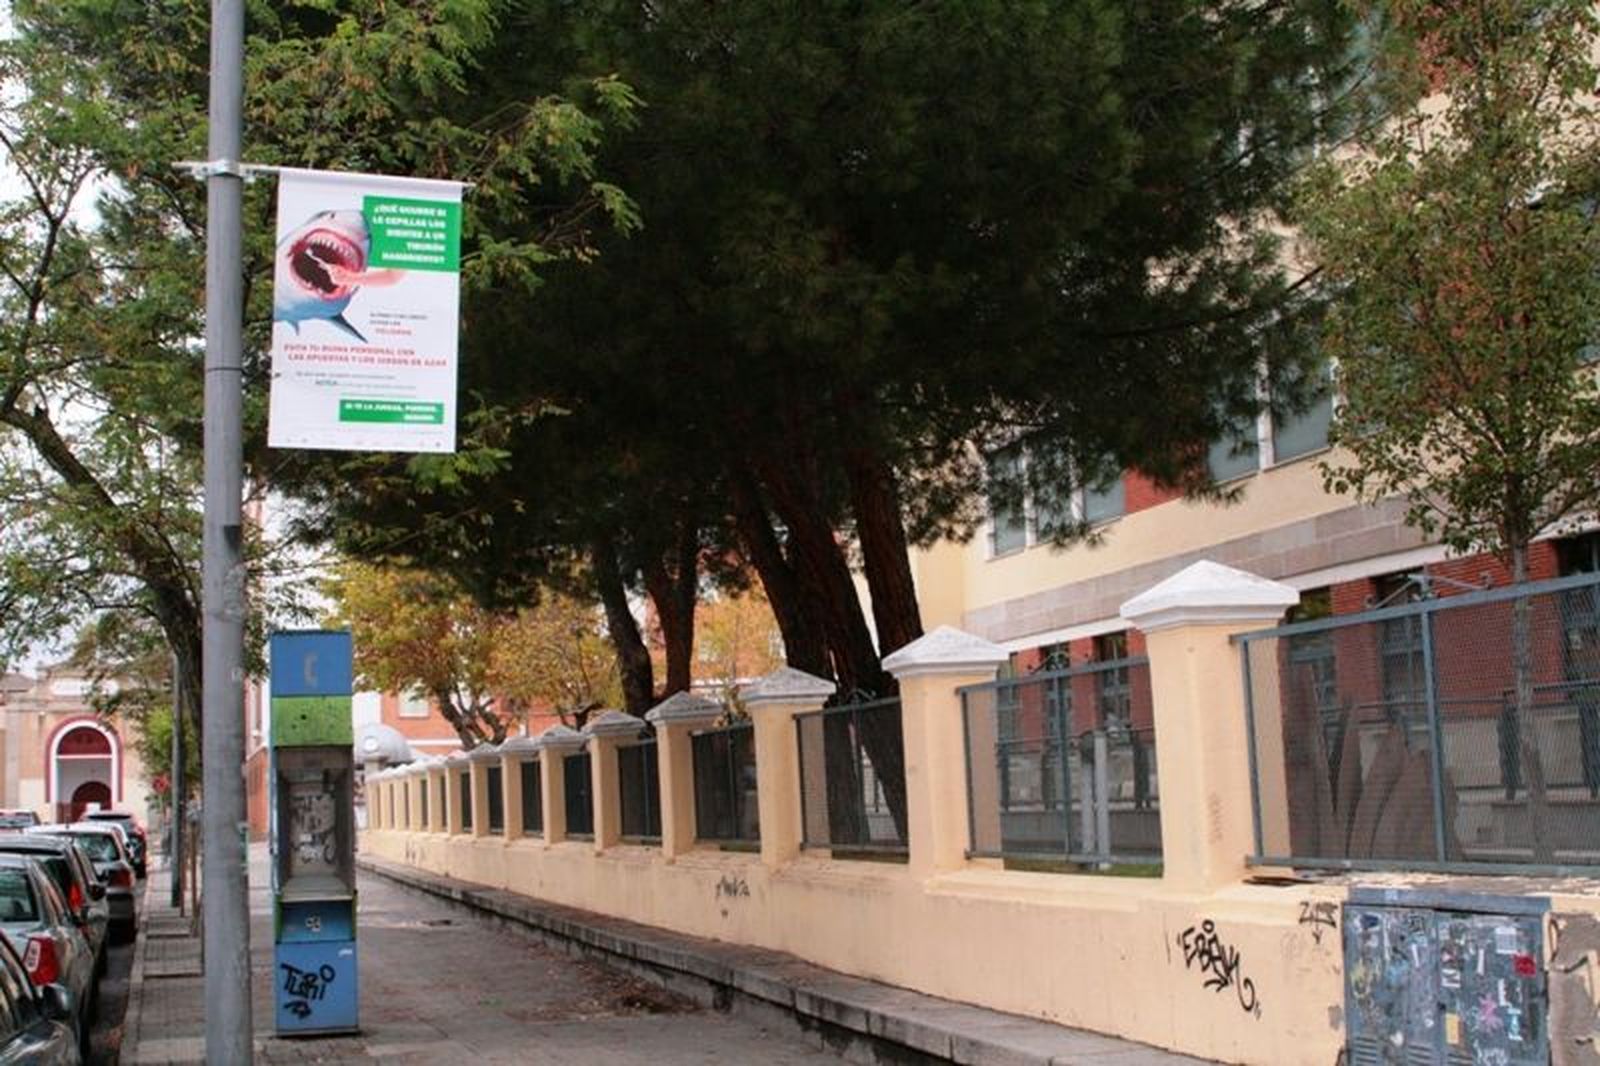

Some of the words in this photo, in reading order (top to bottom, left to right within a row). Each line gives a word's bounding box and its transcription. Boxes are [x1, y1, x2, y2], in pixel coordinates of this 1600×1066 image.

[373, 216, 384, 224] LE
[386, 217, 426, 228] CEPILLAS
[428, 219, 446, 229] LOS
[425, 231, 431, 240] A
[432, 232, 446, 241] UN
[350, 346, 394, 355] PERSONAL
[288, 353, 304, 361] LAS
[358, 356, 375, 364] LOS
